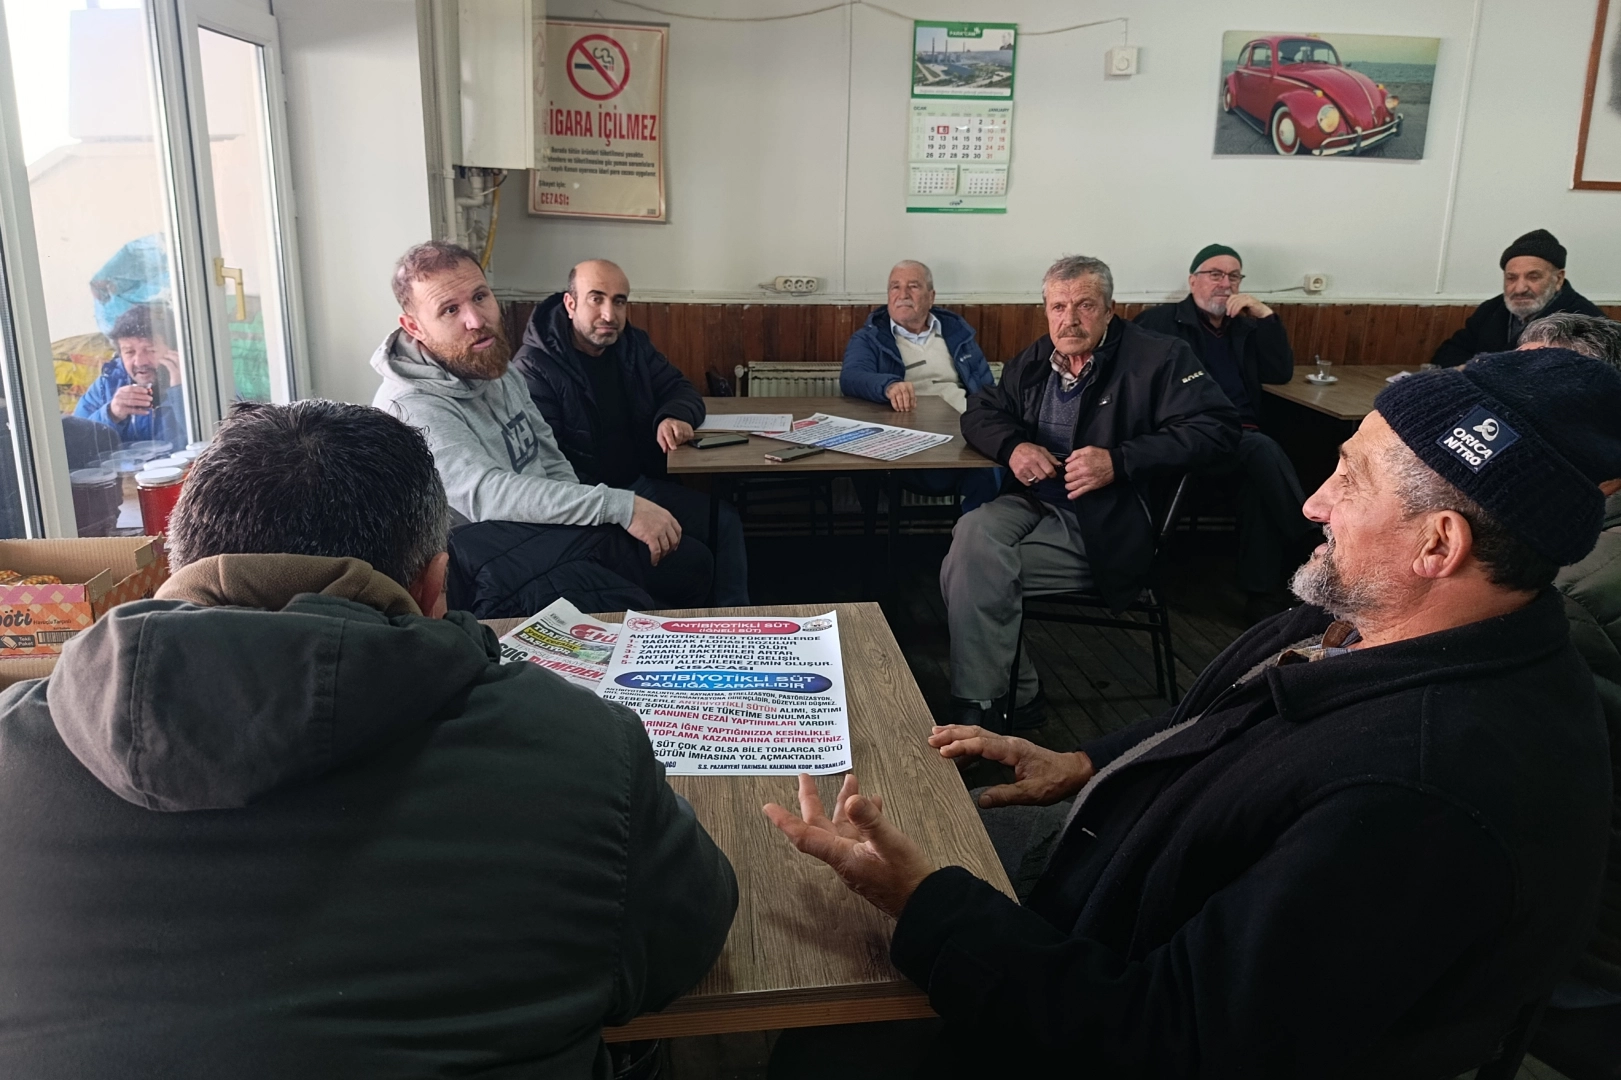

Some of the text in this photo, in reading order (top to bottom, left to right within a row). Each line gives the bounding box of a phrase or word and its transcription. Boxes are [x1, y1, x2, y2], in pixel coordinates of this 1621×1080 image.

[550, 101, 657, 147] İGARA İÇİLMEZ
[1453, 428, 1493, 459] ORICA
[0, 608, 32, 628] öti
[630, 673, 816, 683] ANTİBİYOTİKLİ SÜT
[640, 681, 709, 689] SAĞLIĞA
[621, 700, 642, 708] TİME
[645, 702, 700, 711] SOKULMASI
[717, 706, 762, 719] TÜKETİME
[746, 703, 777, 713] SÜTÜN
[654, 710, 700, 719] KANUNEN
[702, 713, 729, 723] CEZAİ
[731, 717, 797, 726] YAPTIRIMLARI
[653, 729, 700, 740] TOPLAMA
[702, 734, 771, 743] KAZANLARINA
[681, 722, 704, 732] İĞNE
[707, 726, 773, 736] YAPTIĞINIZDA
[656, 740, 676, 748] SÜT
[678, 742, 698, 751] ÇOK
[818, 744, 843, 753] SÜTÜ
[654, 749, 686, 758] SÜTÜN
[688, 751, 736, 761] İMHASINA
